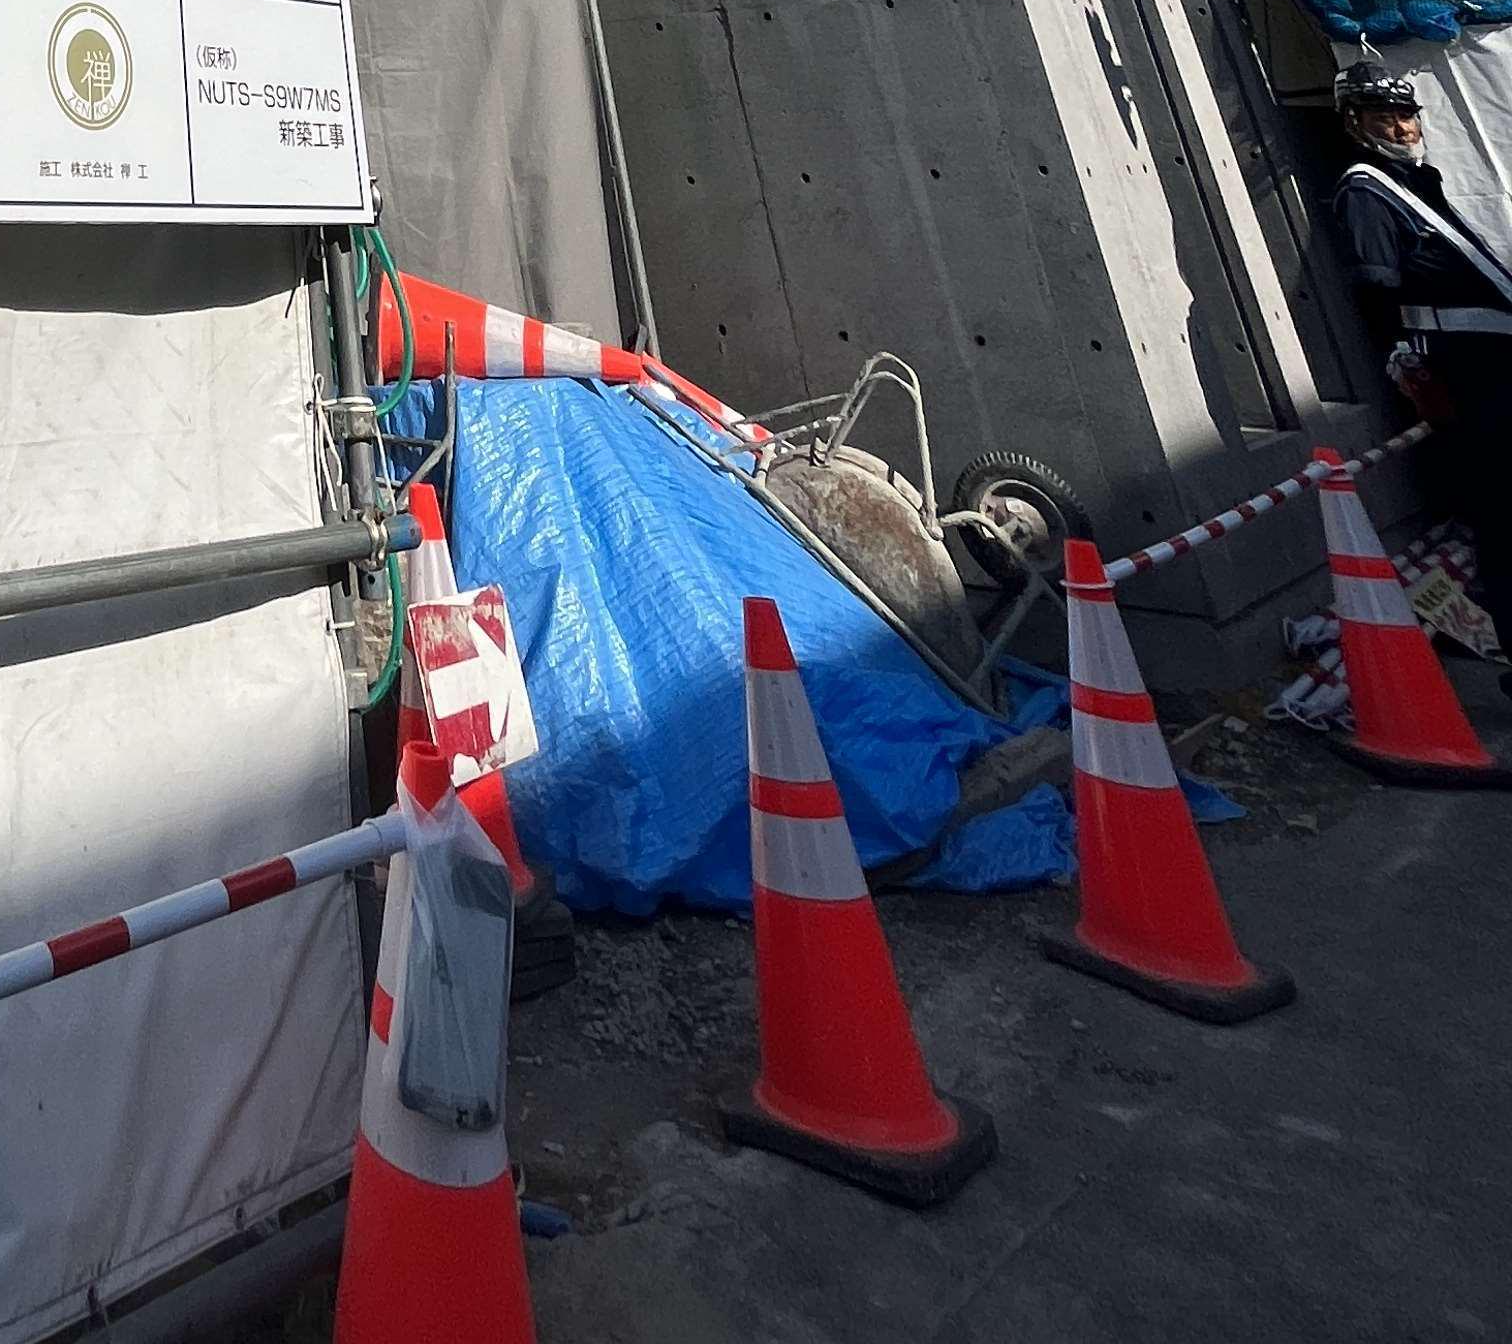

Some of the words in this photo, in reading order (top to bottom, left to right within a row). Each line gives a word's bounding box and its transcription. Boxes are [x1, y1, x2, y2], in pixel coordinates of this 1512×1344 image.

[196, 44, 238, 71] (仮称)
[80, 50, 115, 101] 禅
[198, 78, 342, 113] NUTS-S9W7MS
[278, 119, 345, 149] 新築工事
[39, 160, 62, 178] 施工
[70, 162, 114, 179] 株式会社
